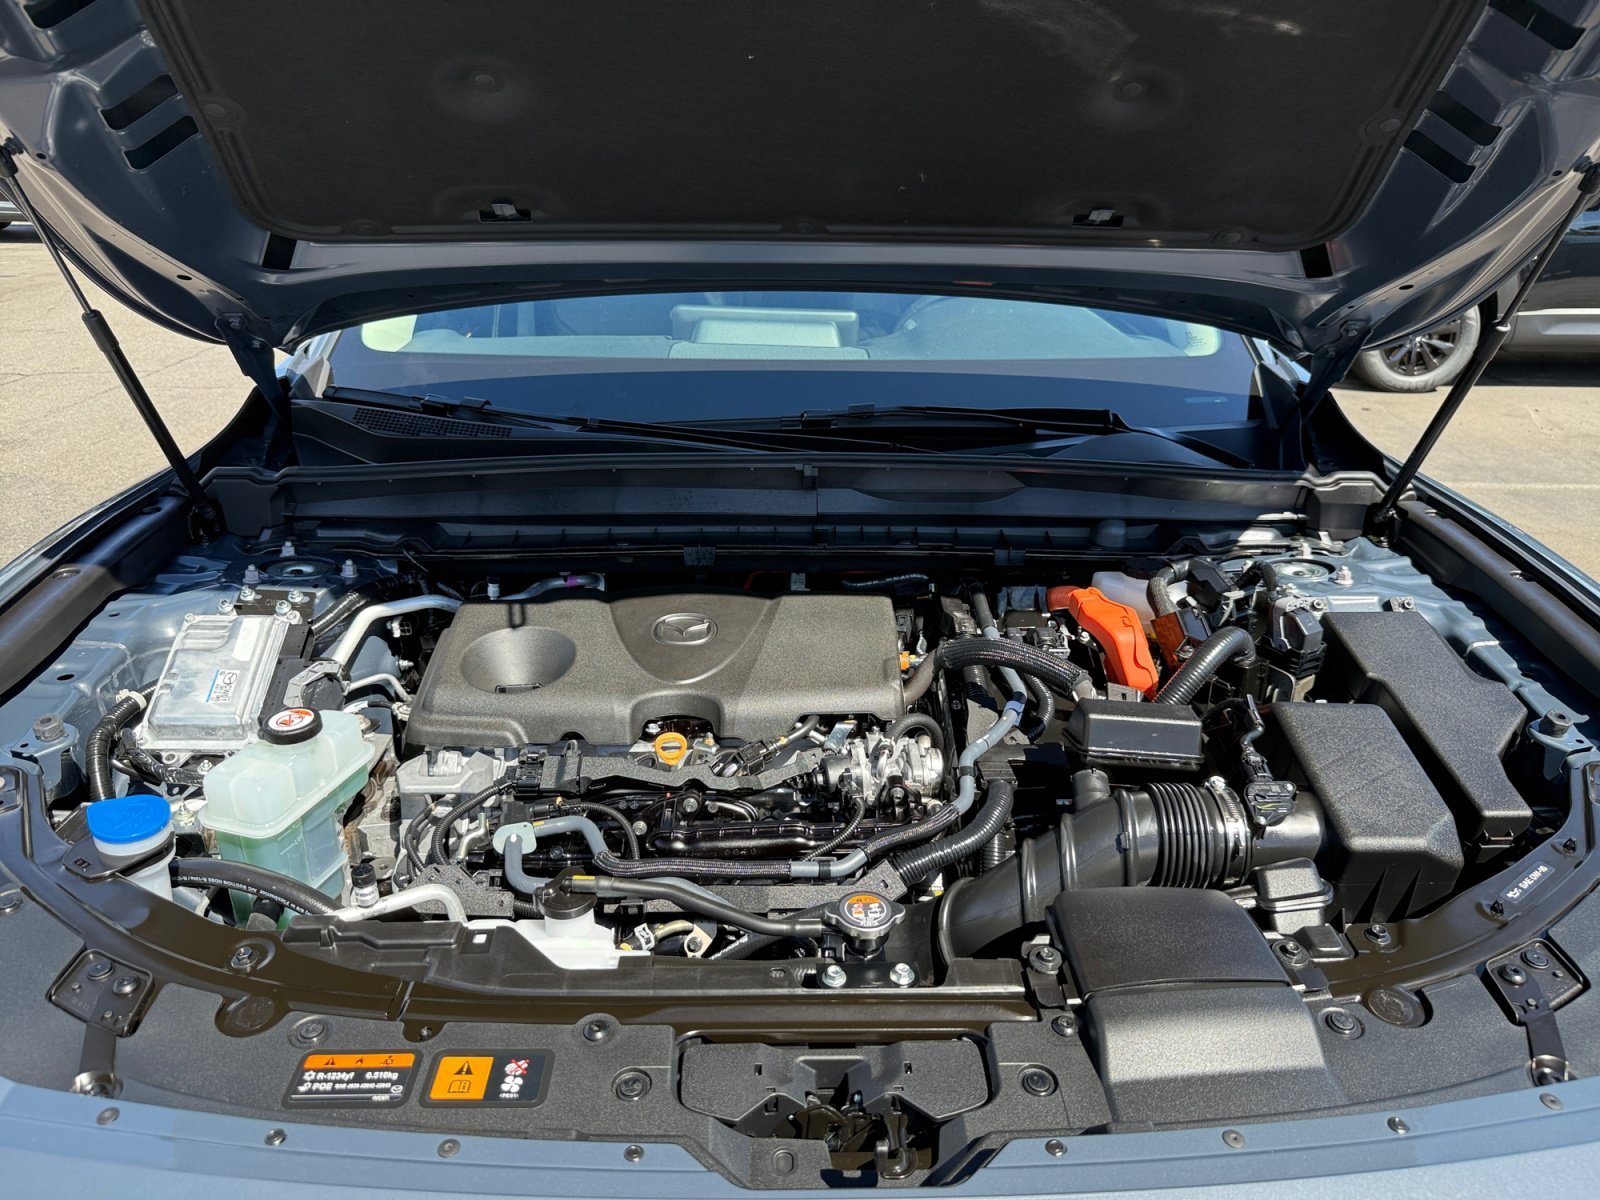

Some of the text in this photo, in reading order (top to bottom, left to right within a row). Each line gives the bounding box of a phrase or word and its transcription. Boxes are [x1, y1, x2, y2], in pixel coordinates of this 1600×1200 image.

[224, 880, 247, 890] SUCTION
[1518, 876, 1535, 889] SAE
[316, 1071, 399, 1081] R-1234yf 0.510kg
[312, 1082, 333, 1091] POE
